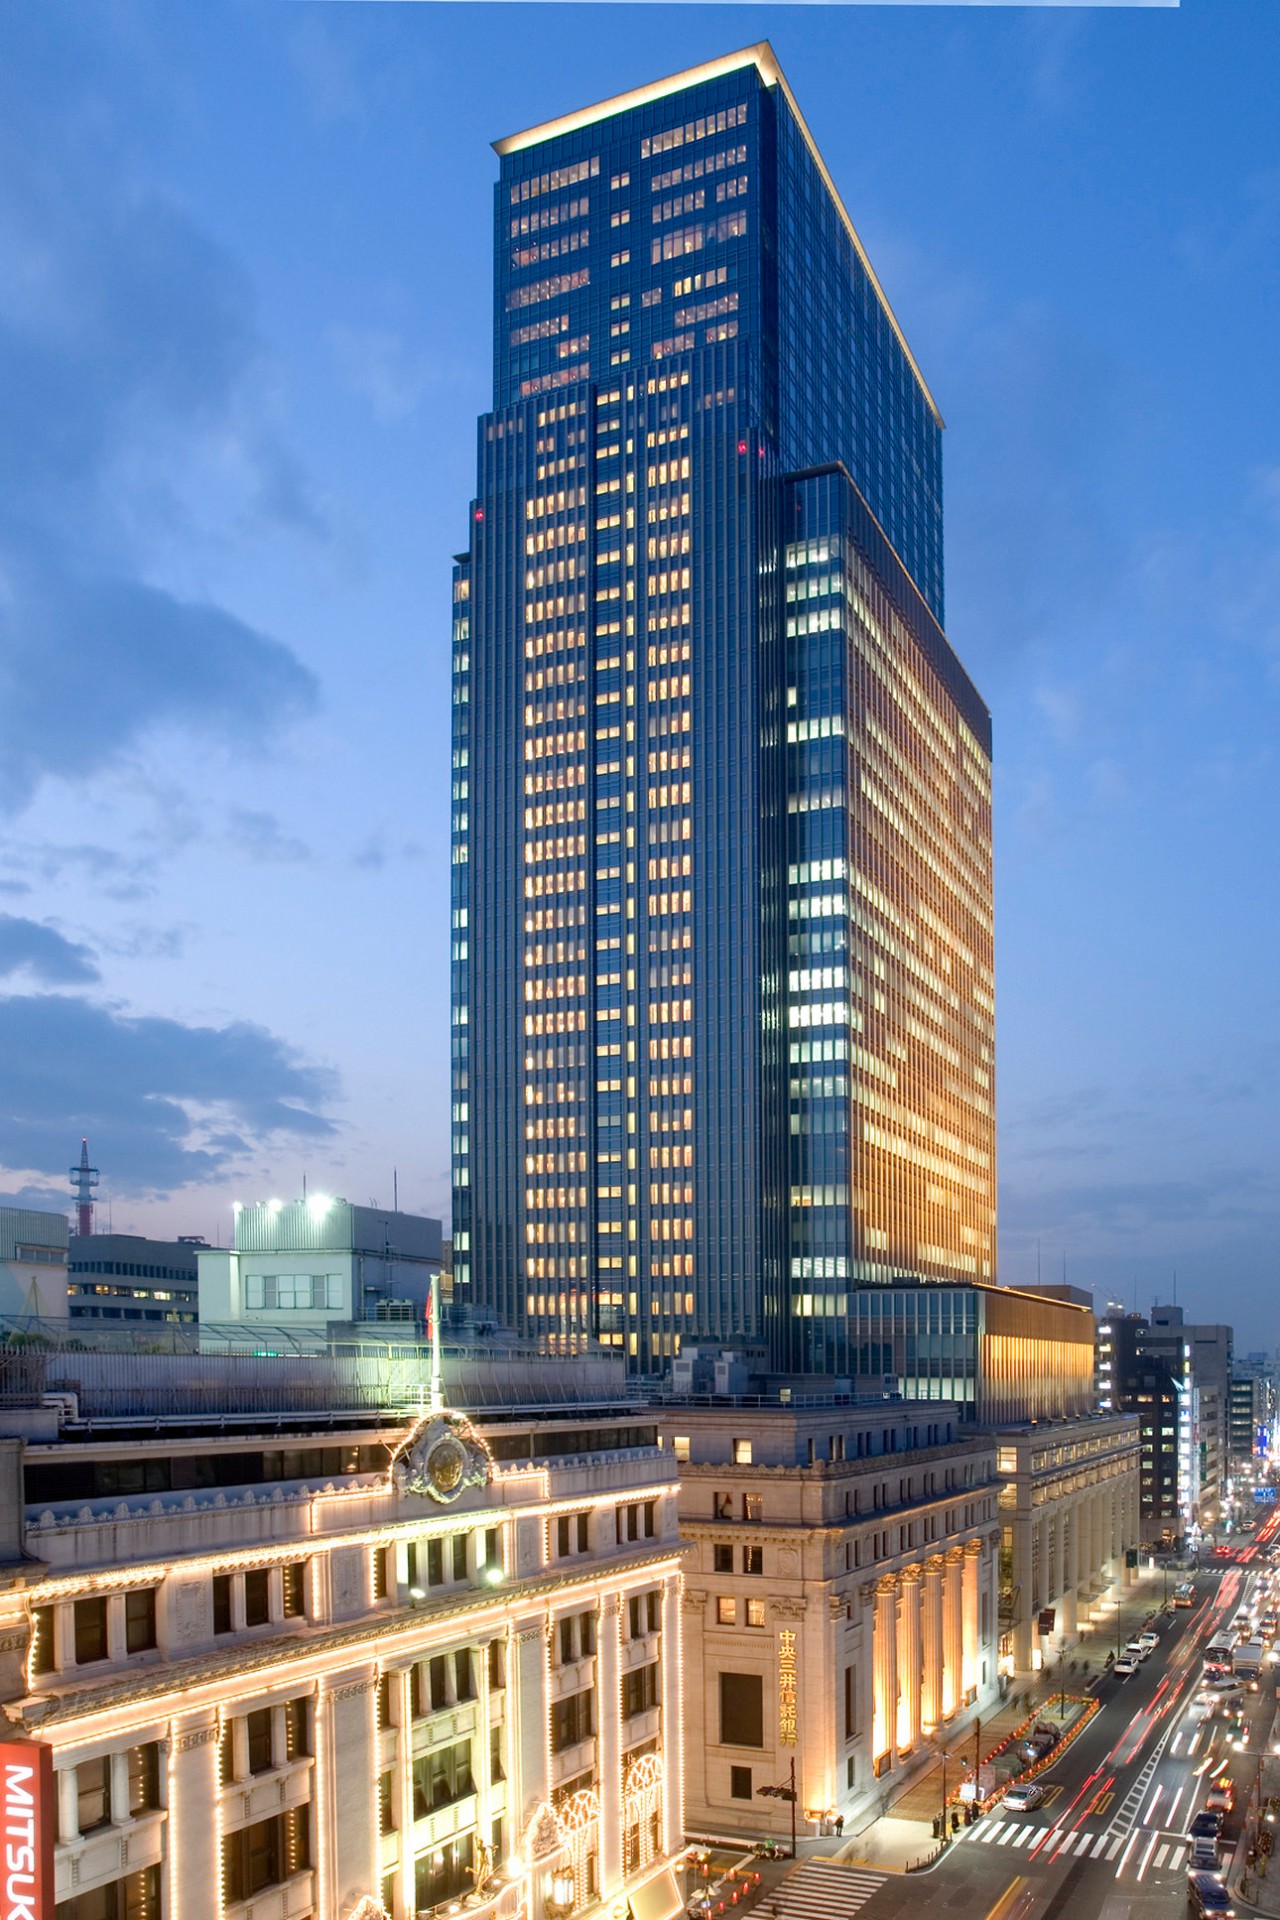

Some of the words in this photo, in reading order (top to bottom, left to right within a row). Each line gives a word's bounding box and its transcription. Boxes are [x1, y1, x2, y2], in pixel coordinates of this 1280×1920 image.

[778, 1629, 798, 1749] 中央三井信託銀行
